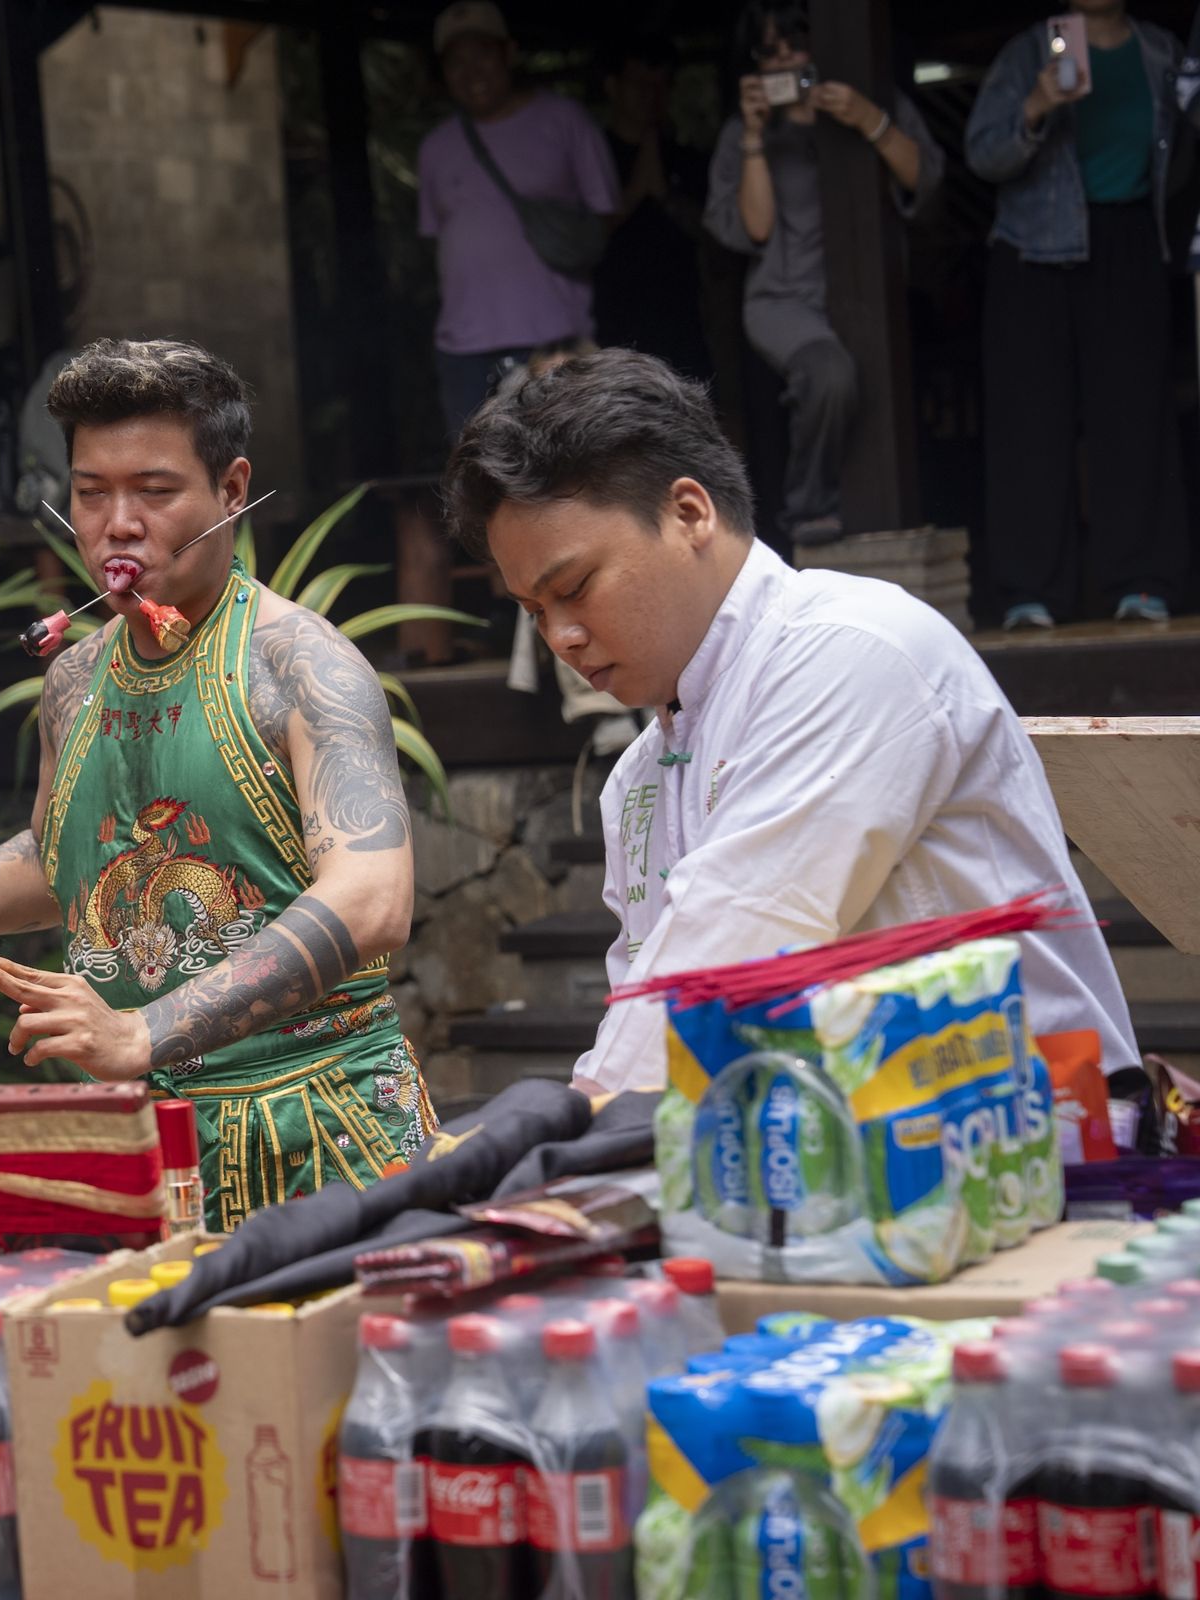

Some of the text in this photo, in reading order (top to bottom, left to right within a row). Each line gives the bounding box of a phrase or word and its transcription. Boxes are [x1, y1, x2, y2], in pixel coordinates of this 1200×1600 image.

[766, 1085, 800, 1200] ISOPLUS
[70, 1398, 207, 1472] FRUIT
[73, 1467, 206, 1551] TEA
